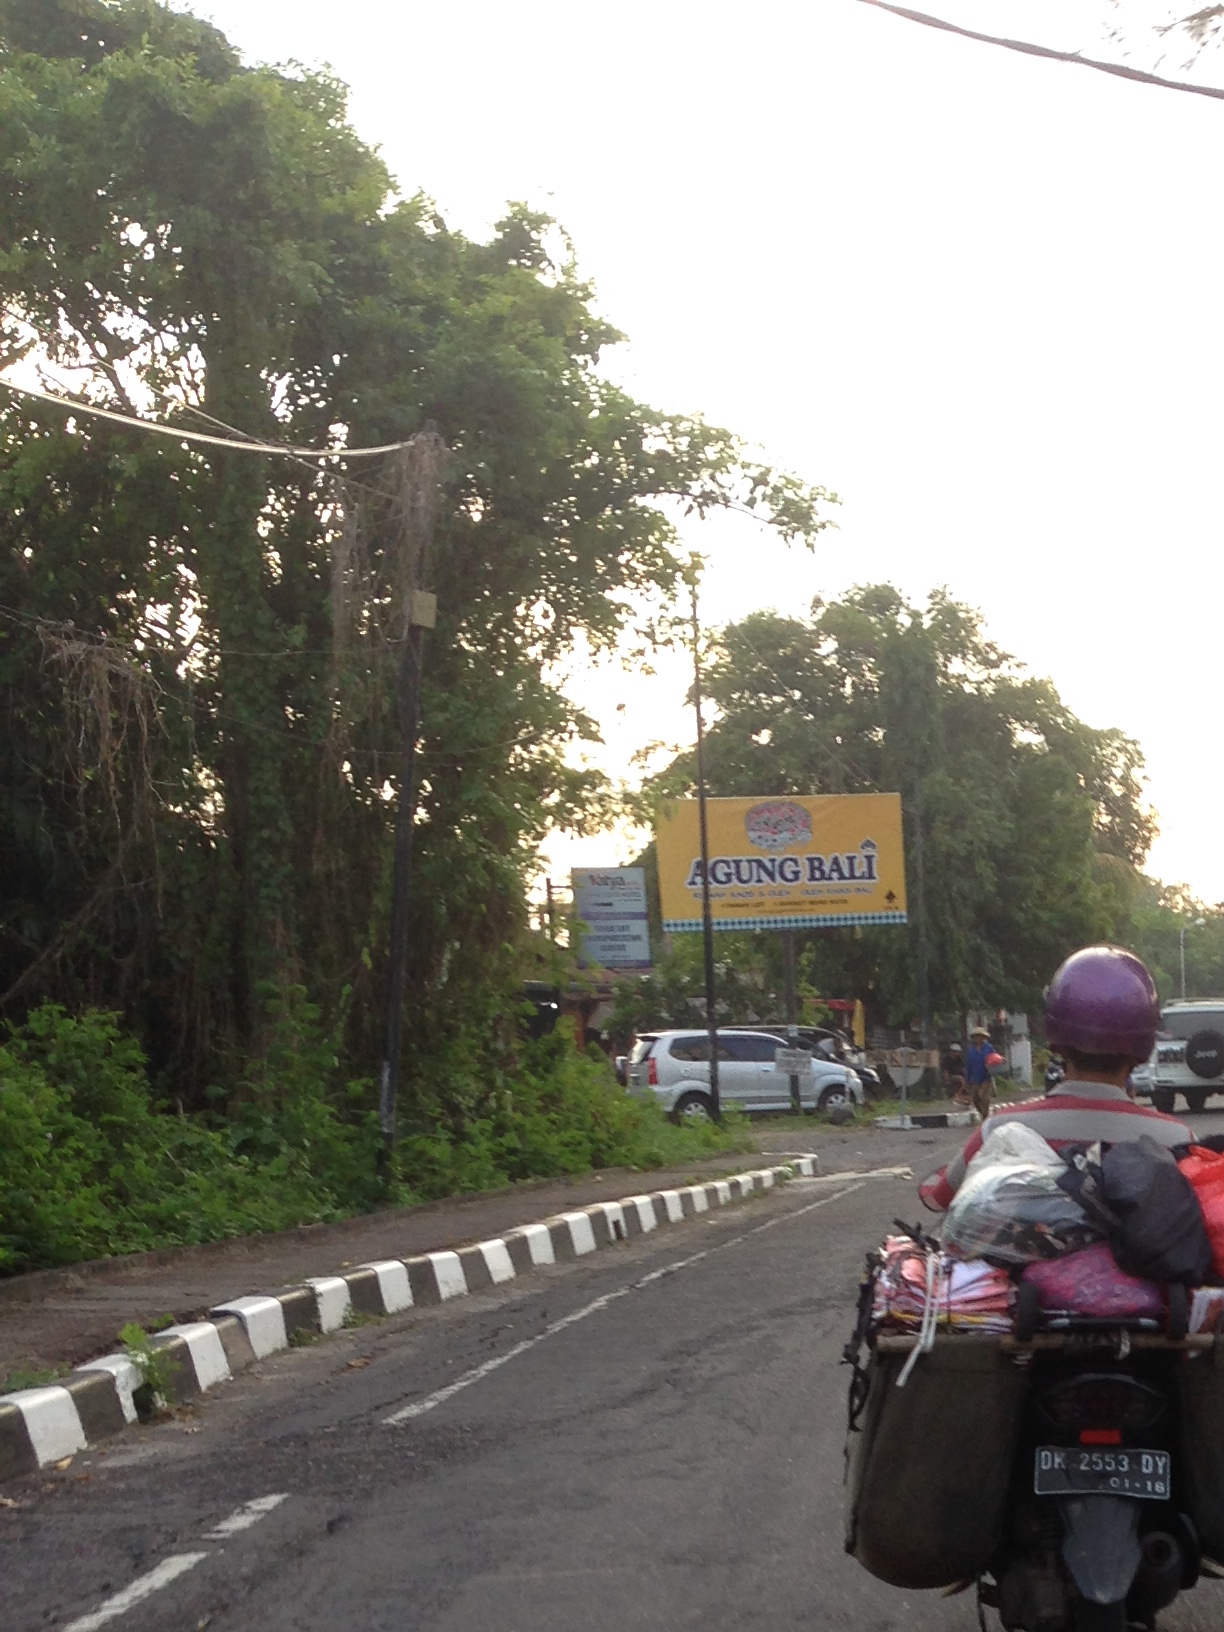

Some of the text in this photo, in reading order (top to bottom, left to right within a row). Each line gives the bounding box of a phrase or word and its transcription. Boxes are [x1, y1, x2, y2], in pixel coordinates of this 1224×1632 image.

[688, 843, 877, 886] AGUNG BALI
[1040, 1450, 1166, 1475] DK 2553 DY
